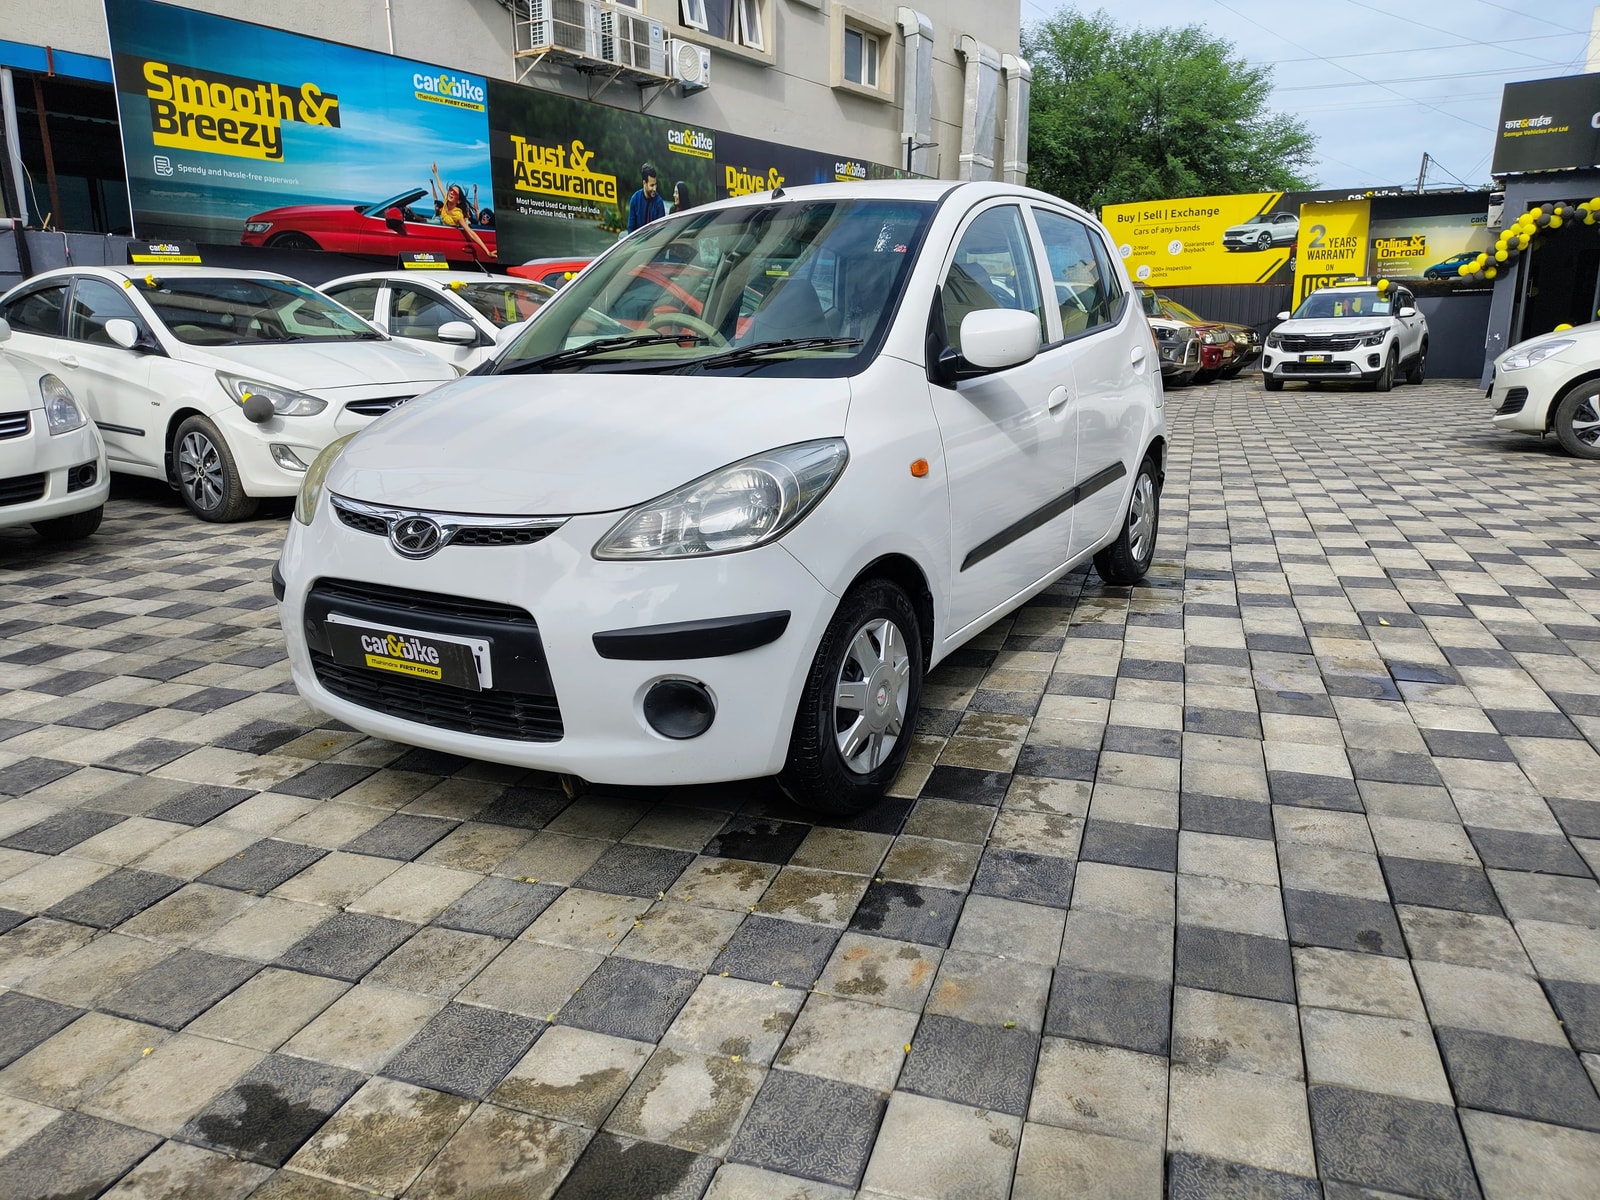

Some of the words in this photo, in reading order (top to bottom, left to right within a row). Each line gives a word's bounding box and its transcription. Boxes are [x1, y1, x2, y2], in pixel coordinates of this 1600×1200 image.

[143, 61, 294, 121] Smooth
[298, 82, 339, 127] &
[413, 73, 484, 102] car&bike
[149, 98, 283, 159] Breezy
[668, 129, 713, 151] car&bike
[510, 135, 566, 168] Trust
[570, 139, 595, 173] &
[177, 163, 206, 176] Speedy
[208, 168, 222, 176] and
[223, 169, 262, 182] hassle-free
[264, 175, 300, 185] paperwork
[514, 161, 615, 199] Assurance
[725, 165, 765, 192] Drive
[834, 161, 866, 178] car&bike
[516, 197, 530, 206] Most
[530, 199, 545, 208] loved
[546, 201, 558, 209] Used
[568, 204, 582, 212] brand
[520, 206, 528, 216] By
[528, 208, 553, 217] Franchise
[554, 212, 568, 220] India,
[1117, 213, 1136, 224] Buy
[1143, 210, 1162, 220] Sell
[1170, 208, 1220, 218] Exchange
[1134, 228, 1150, 236] Cars
[1151, 226, 1159, 234] of
[1160, 226, 1173, 234] any
[1174, 224, 1200, 232] brands
[1308, 224, 1326, 249] 2
[1328, 236, 1358, 248] YEARS
[1307, 248, 1356, 261] WARRANTY
[1375, 238, 1408, 250] Online
[1381, 246, 1426, 258] On-road
[1325, 264, 1334, 272] ON
[1304, 277, 1338, 298] USE
[360, 633, 440, 665] car&bike
[371, 658, 398, 668] Mahindra
[399, 663, 417, 672] FIRST
[417, 666, 439, 676] CHOICE
